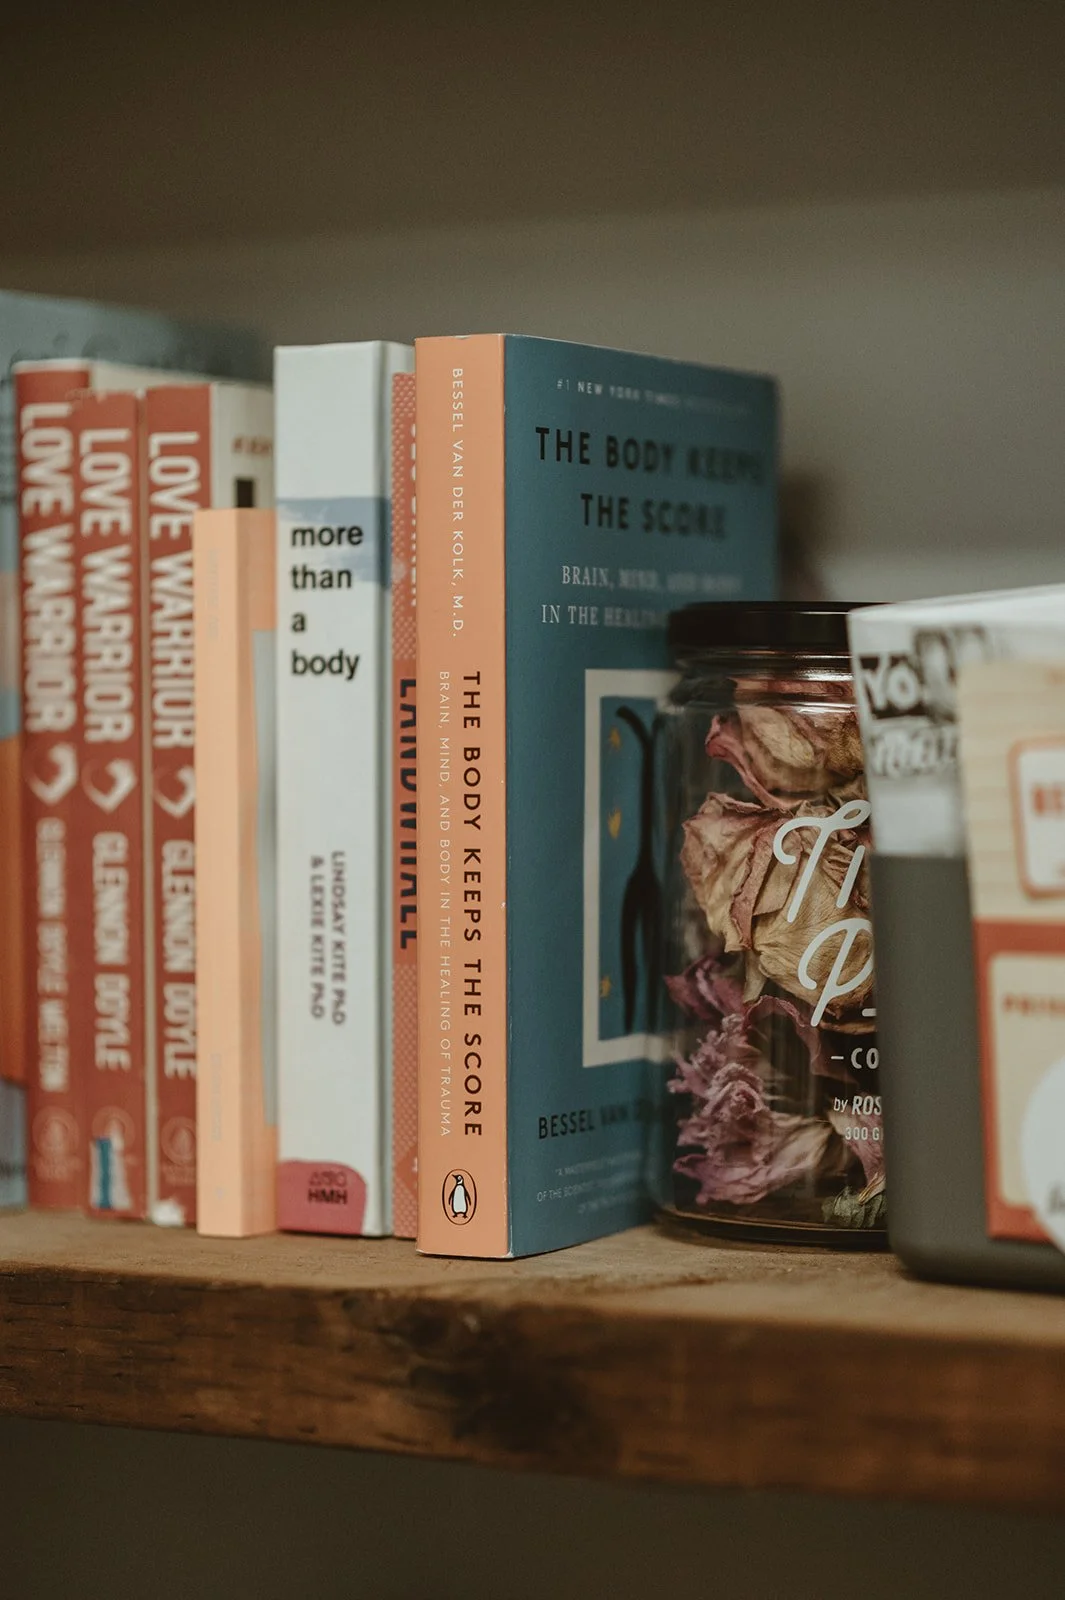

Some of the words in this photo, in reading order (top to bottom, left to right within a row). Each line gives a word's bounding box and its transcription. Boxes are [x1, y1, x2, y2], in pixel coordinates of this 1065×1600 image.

[452, 367, 464, 433] BESSEL
[577, 381, 602, 396] NEW
[20, 402, 74, 518] LOVE
[452, 439, 464, 478] VAN
[535, 426, 591, 466] THE
[605, 434, 673, 475] BODY
[78, 427, 133, 537] LOVE
[148, 431, 200, 541] LOVE
[452, 486, 464, 521] DER
[290, 524, 364, 548] more
[580, 493, 630, 531] THE
[290, 566, 353, 590] than
[451, 530, 464, 586] KOLK,
[22, 522, 77, 733] WARRIOR
[290, 611, 307, 634] a
[452, 595, 464, 638] M.D.
[541, 604, 561, 624] IN
[567, 605, 599, 627] THE
[80, 544, 134, 743] WARRIOR
[150, 549, 195, 749] WARRIOR
[290, 648, 361, 681] body
[438, 671, 450, 729] BRAIN,
[463, 671, 481, 729] THE
[438, 736, 451, 787] MIND,
[439, 795, 451, 832] AND
[463, 747, 482, 831] BODY
[439, 839, 451, 884] BODY
[310, 874, 325, 929] LEXIE
[331, 850, 347, 934] LINDSAY
[440, 892, 451, 910] IN
[463, 848, 482, 942] KEEPS
[310, 934, 326, 977] KITE
[440, 915, 451, 948] THE
[332, 940, 347, 984] KITE
[440, 956, 452, 1031] HEALING
[464, 959, 482, 1016] THE
[94, 972, 132, 1072] DOYLE
[163, 982, 197, 1079] DOYLE
[440, 1038, 452, 1059] OF
[440, 1065, 452, 1137] TRAUMA
[464, 1033, 483, 1136] SCORE
[833, 1096, 849, 1113] by
[538, 1109, 596, 1140] BESSEL
[845, 1126, 869, 1140] 300
[307, 1187, 348, 1205] HMH
